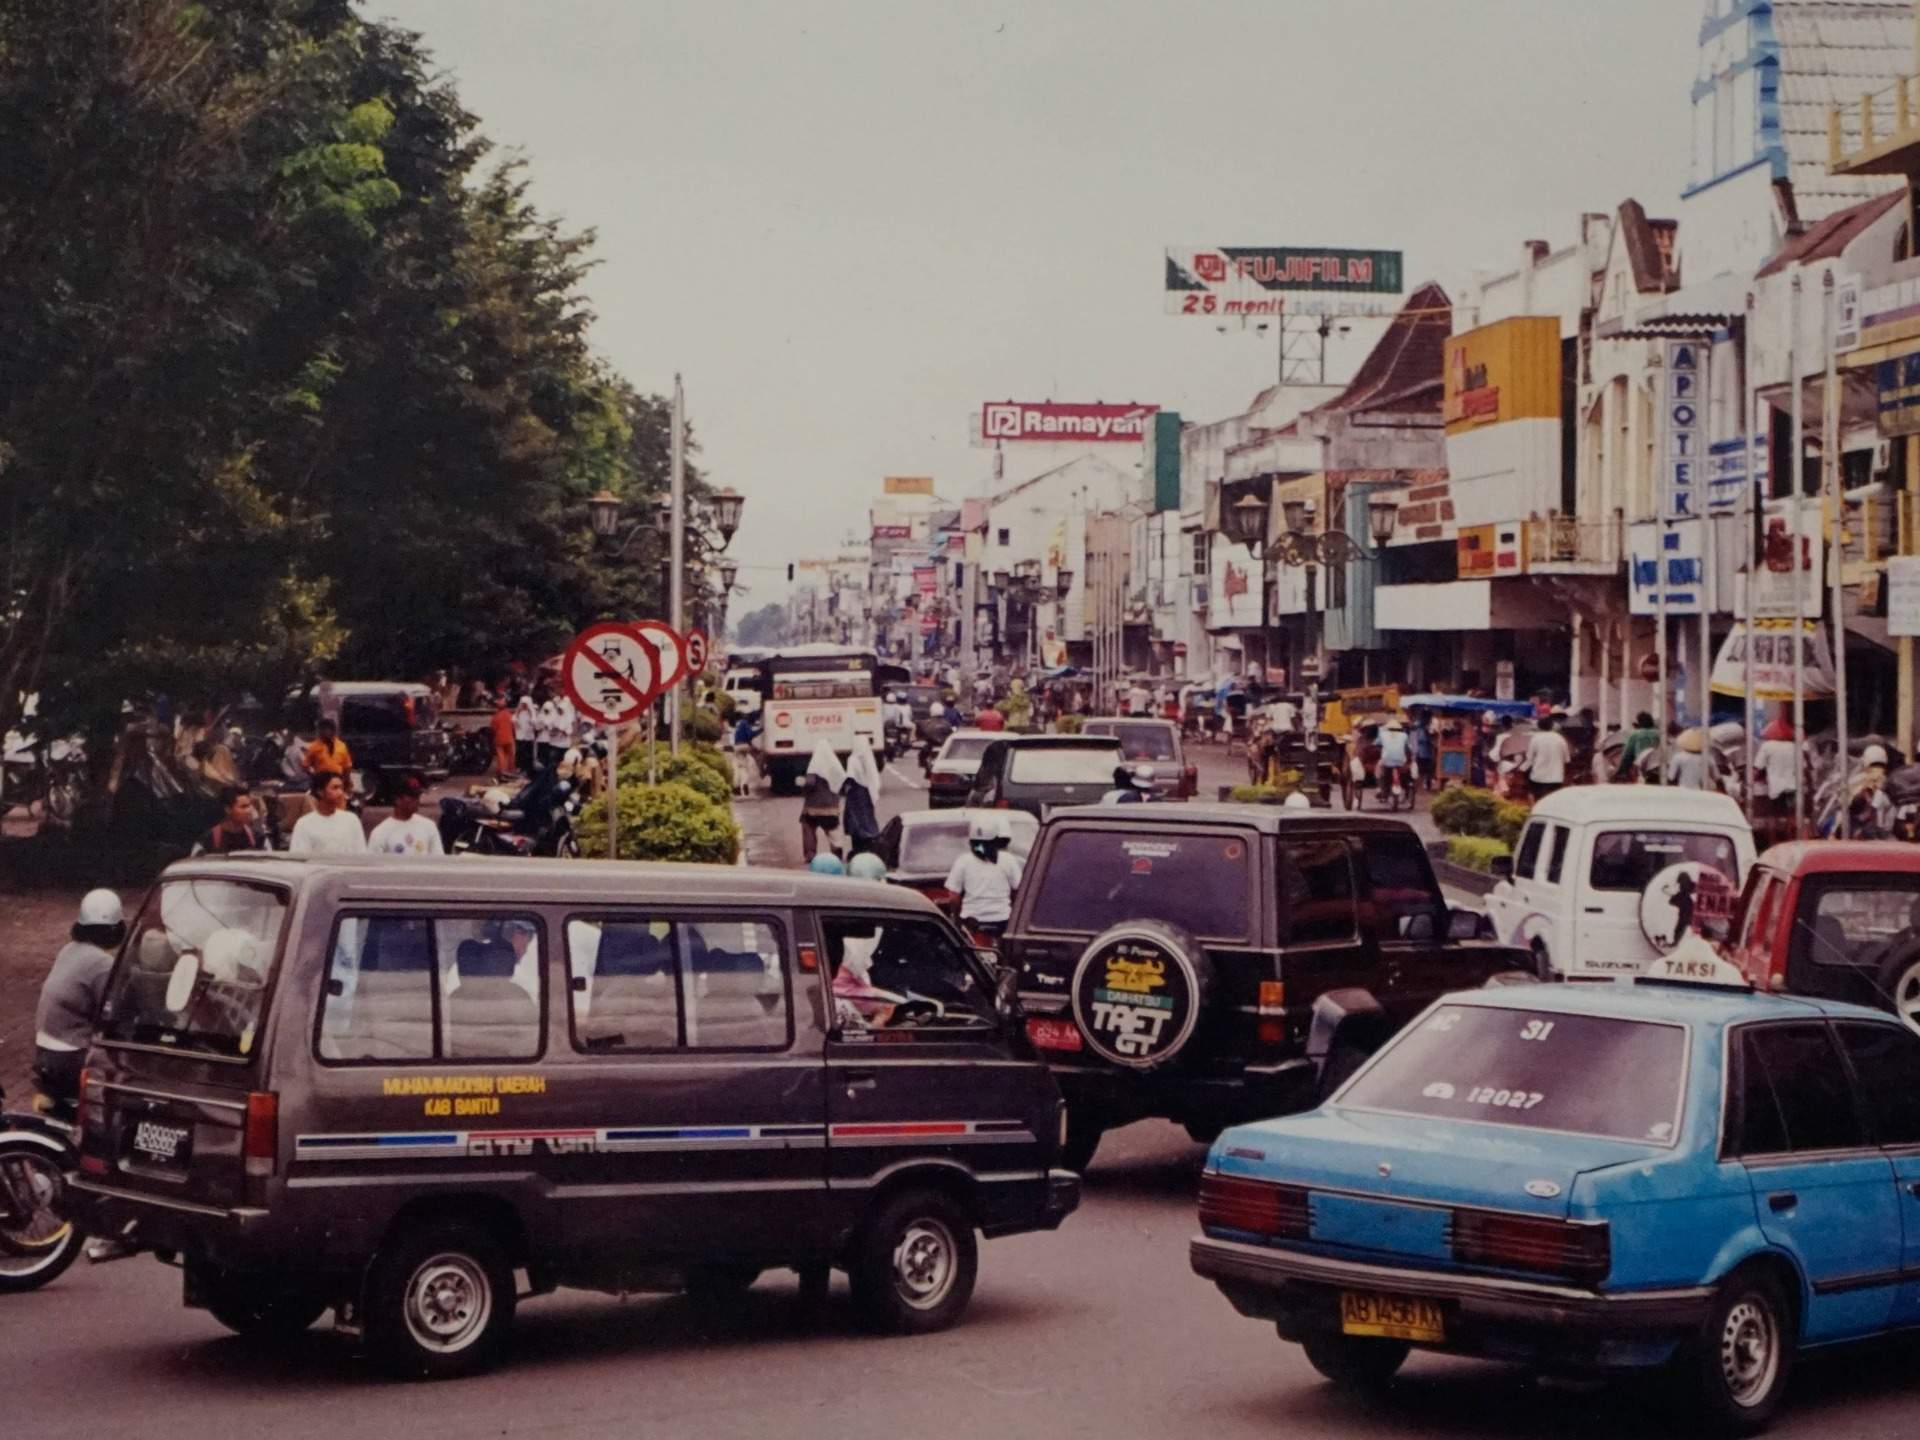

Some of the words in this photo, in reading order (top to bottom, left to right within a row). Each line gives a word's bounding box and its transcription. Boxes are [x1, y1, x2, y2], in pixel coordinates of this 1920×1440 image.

[1236, 255, 1373, 284] FUJIFILM
[1182, 293, 1218, 314] 25
[1224, 295, 1286, 315] menit
[1024, 411, 1145, 438] Ramayan
[1674, 346, 1695, 514] APOTEK
[1585, 960, 1640, 970] SUZUKI
[1665, 961, 1716, 977] TAKSI
[1091, 1002, 1172, 1037] TAFT
[1519, 1019, 1555, 1041] 31
[1115, 1034, 1158, 1057] GT
[497, 1076, 546, 1094] DAERAH
[425, 1098, 451, 1116] KAB
[1466, 1085, 1545, 1110] 12027
[1345, 1294, 1370, 1322] AB
